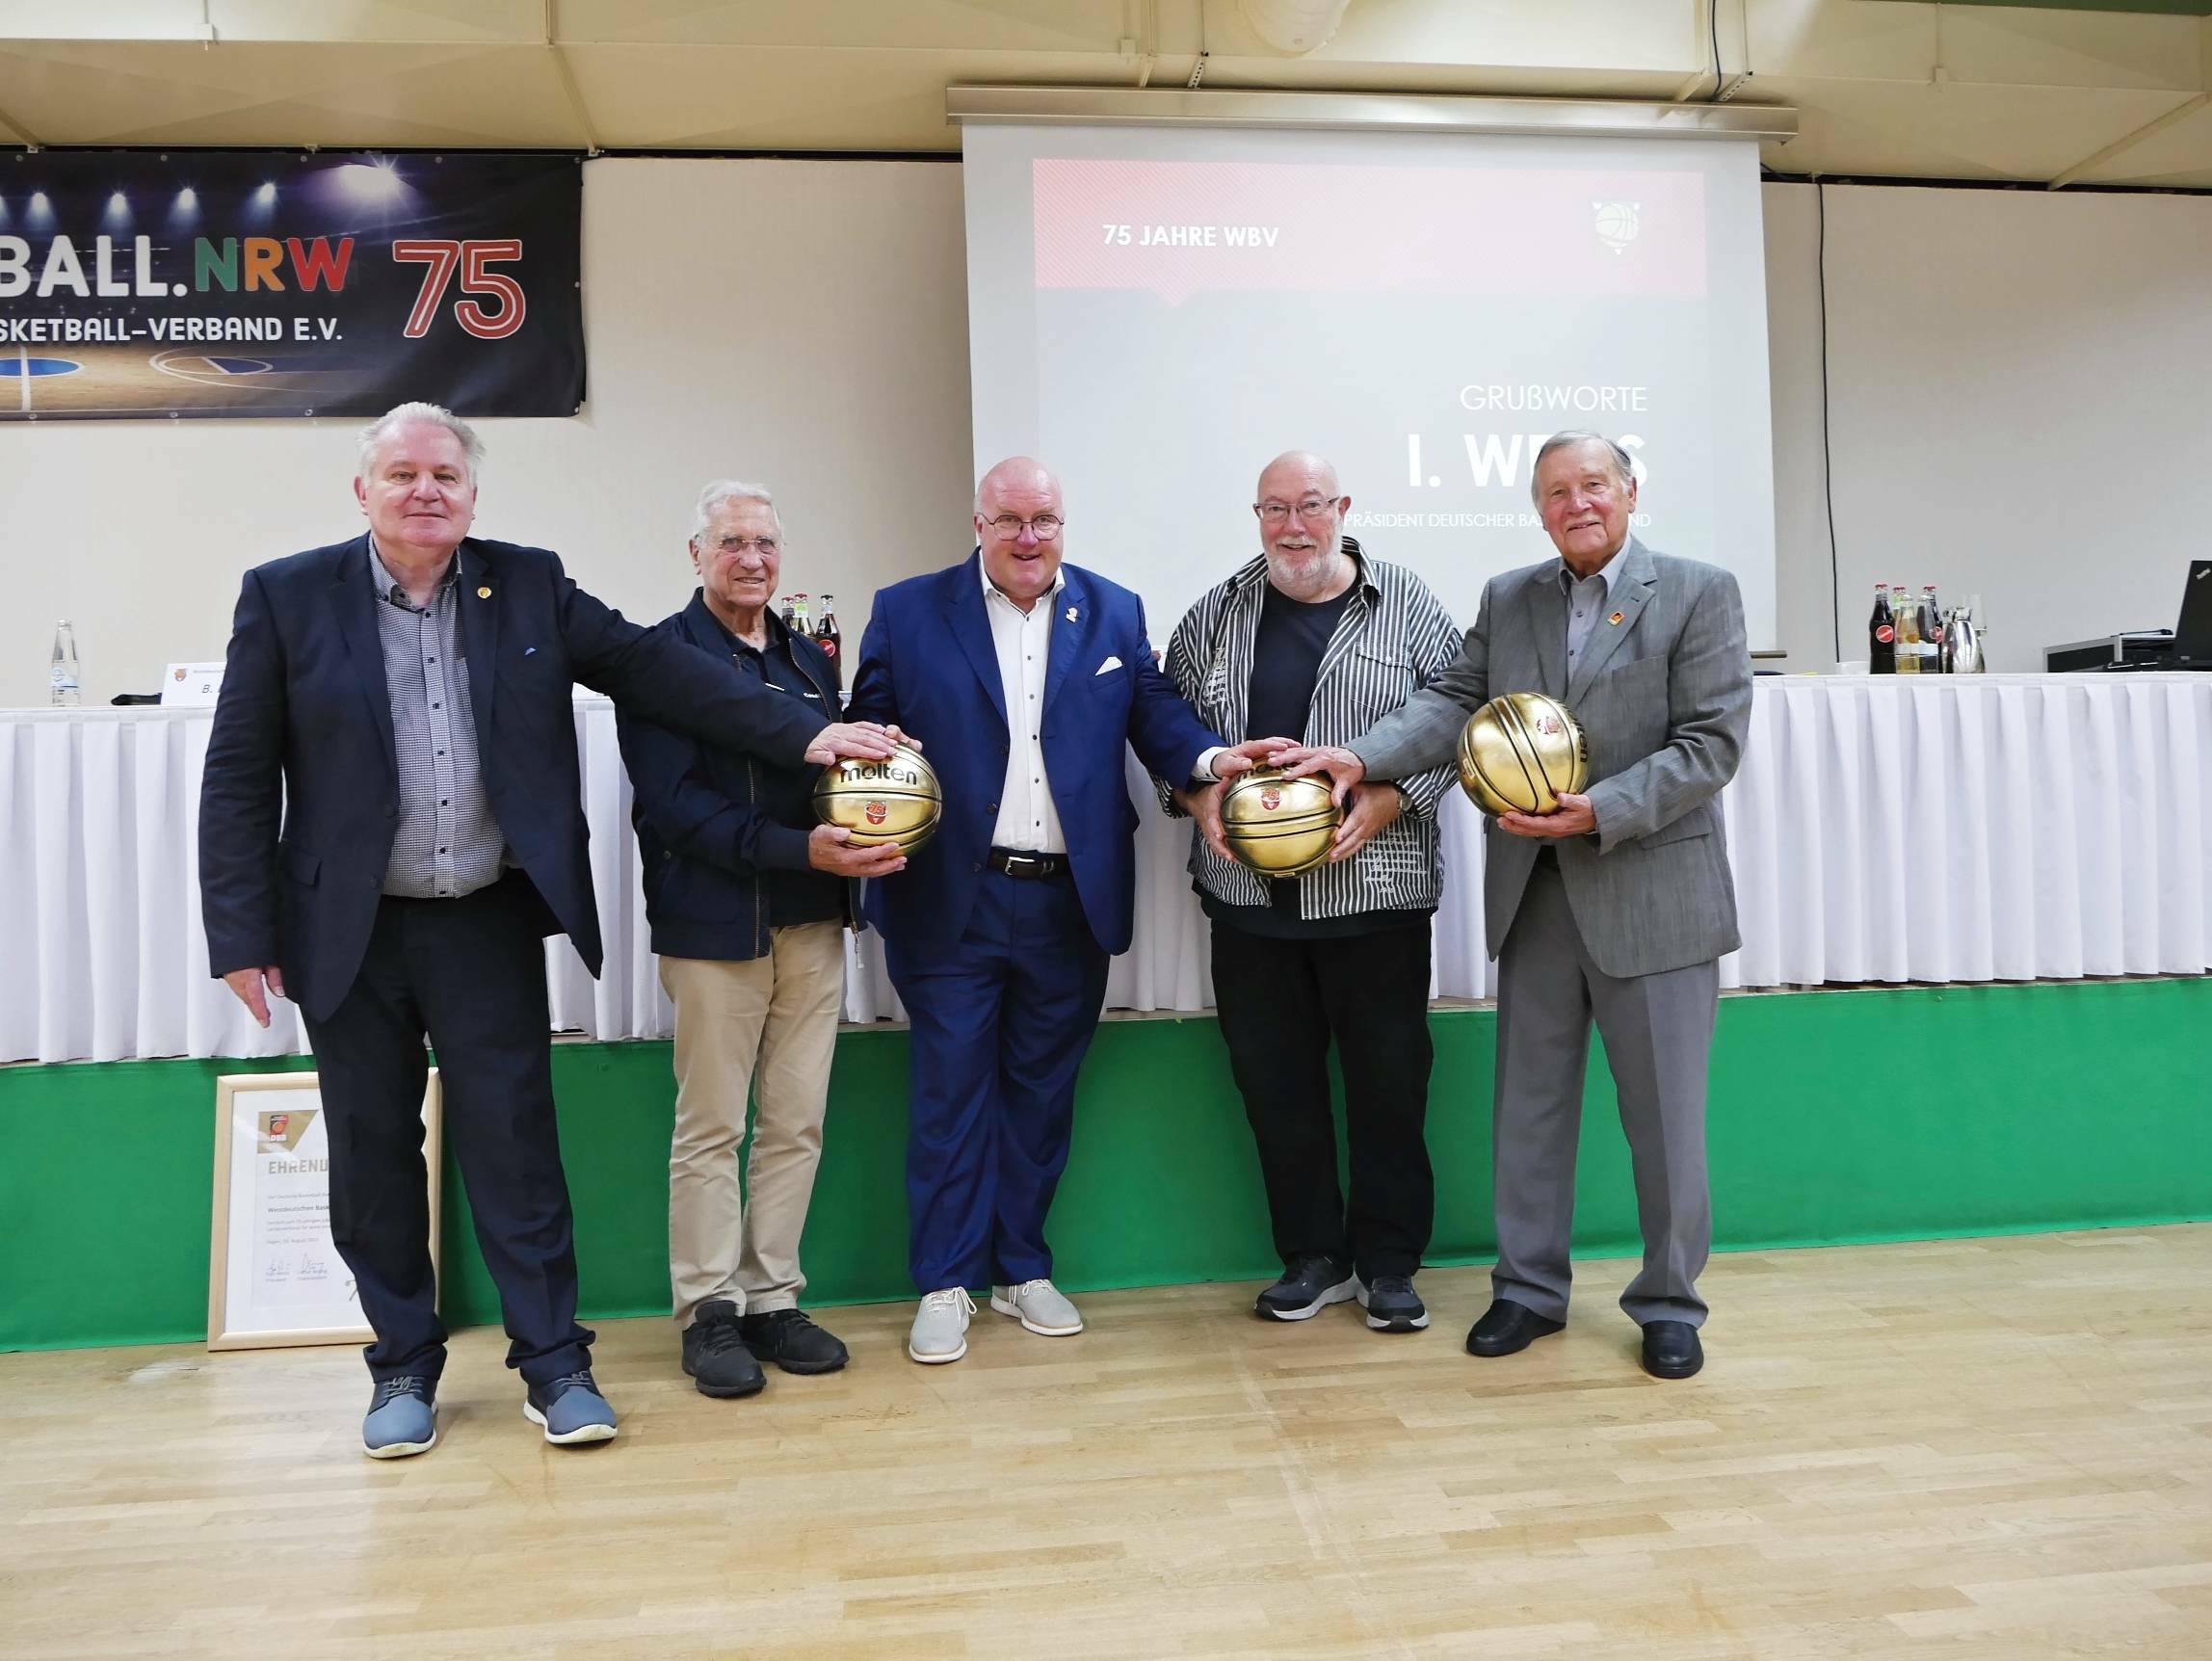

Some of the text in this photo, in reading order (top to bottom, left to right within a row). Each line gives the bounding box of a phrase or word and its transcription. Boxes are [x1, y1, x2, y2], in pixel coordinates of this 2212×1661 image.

[1102, 224, 1280, 249] 75 JAHRE WBV
[0, 234, 355, 298] BALL.NRW
[392, 238, 527, 340] 75
[293, 317, 343, 342] E.V.
[1460, 384, 1647, 412] GRUßWORTE
[1408, 433, 1442, 488] I.
[1344, 511, 1426, 528] PRÄSIDENT
[1429, 513, 1515, 528] DEUTSCHER
[840, 762, 917, 785] molten
